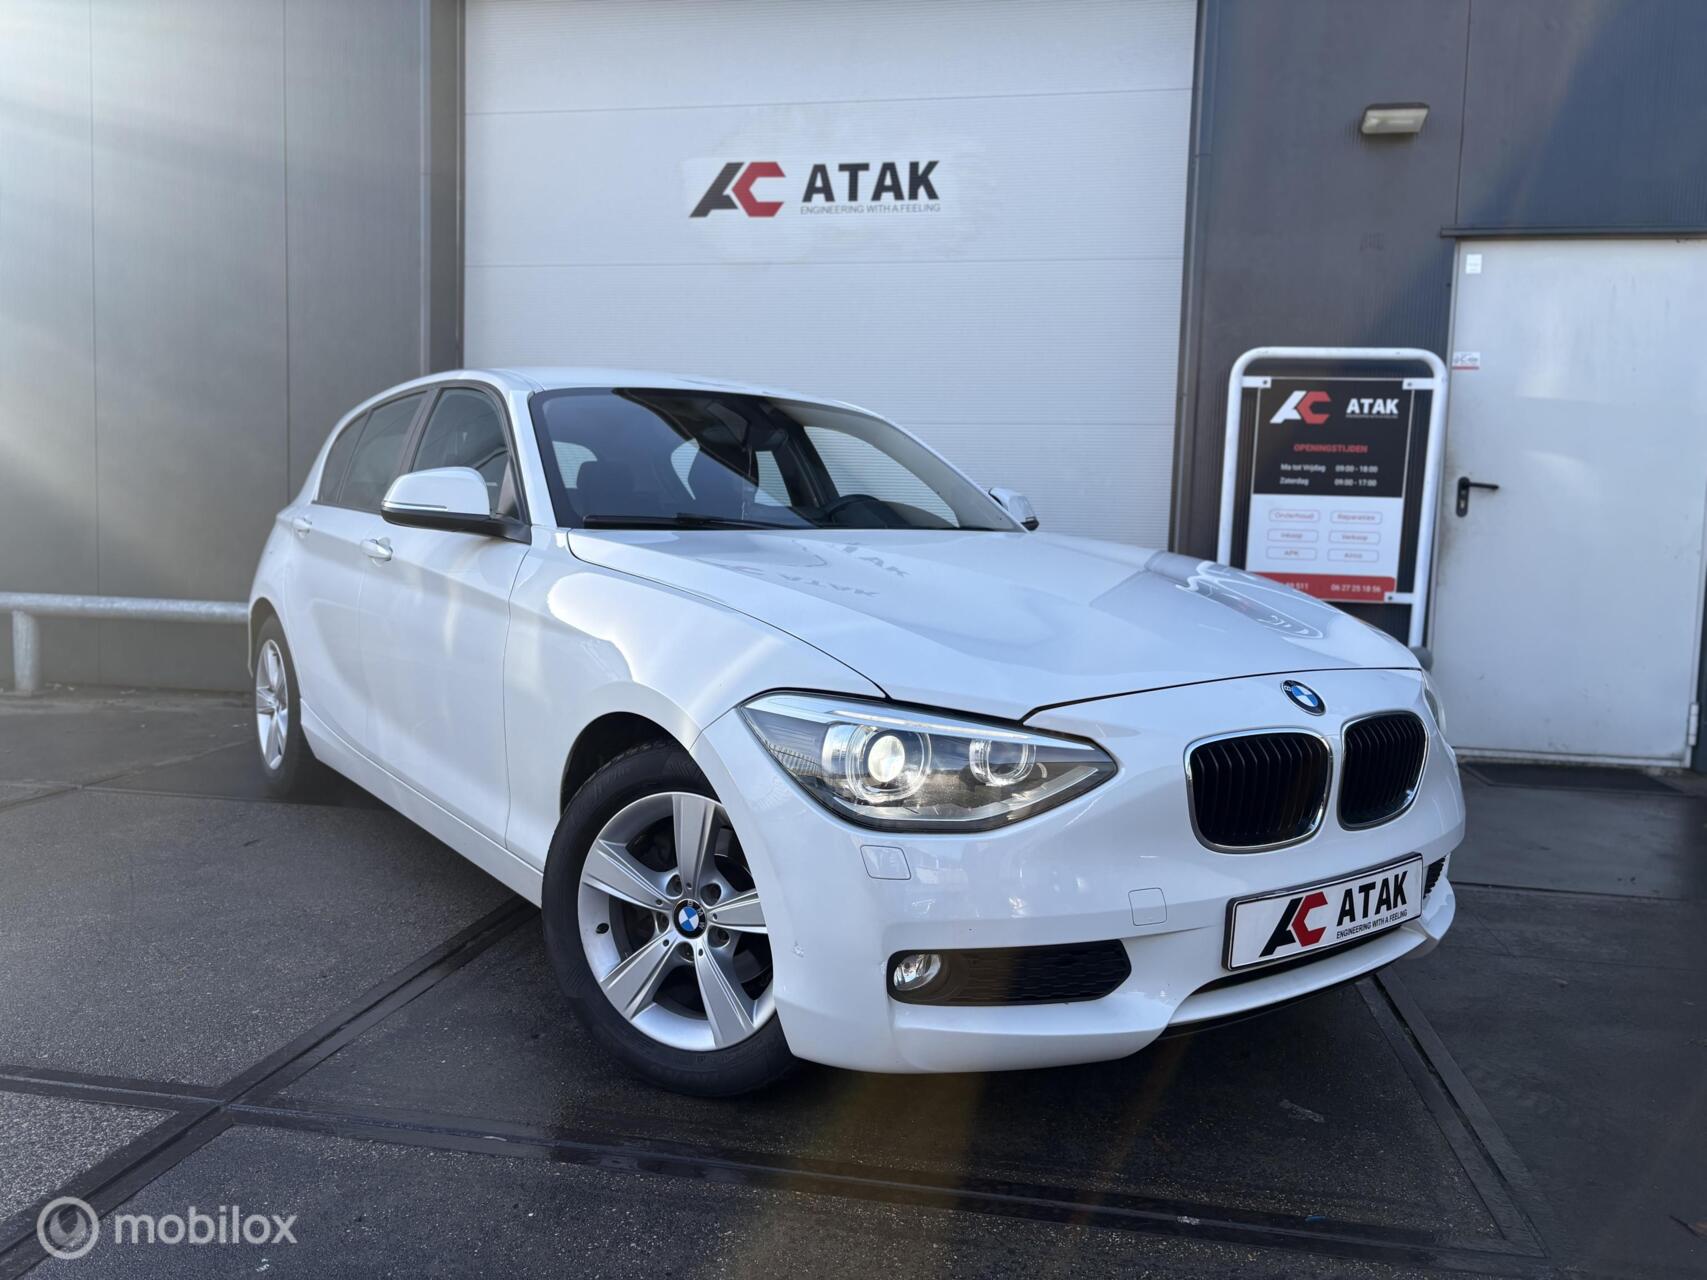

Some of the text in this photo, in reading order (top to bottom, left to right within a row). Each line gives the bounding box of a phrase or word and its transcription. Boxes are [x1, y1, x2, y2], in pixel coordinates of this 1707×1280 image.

[801, 160, 940, 202] ATAK
[800, 203, 941, 215] ENGINEERING WITH A FEELING
[1346, 398, 1399, 414] ATAK
[1293, 443, 1368, 453] OPENINGSTIJDEN
[1303, 464, 1326, 473] Vrijdag
[1279, 476, 1309, 486] Zaterdag
[1274, 512, 1314, 520] Onderhoud
[1342, 534, 1368, 542] Verkoop
[1341, 584, 1351, 592] 27
[1336, 870, 1408, 926] ATAK
[1336, 921, 1372, 939] ENGINEERING
[1372, 917, 1385, 928] WITH
[1389, 909, 1408, 923] FEELING
